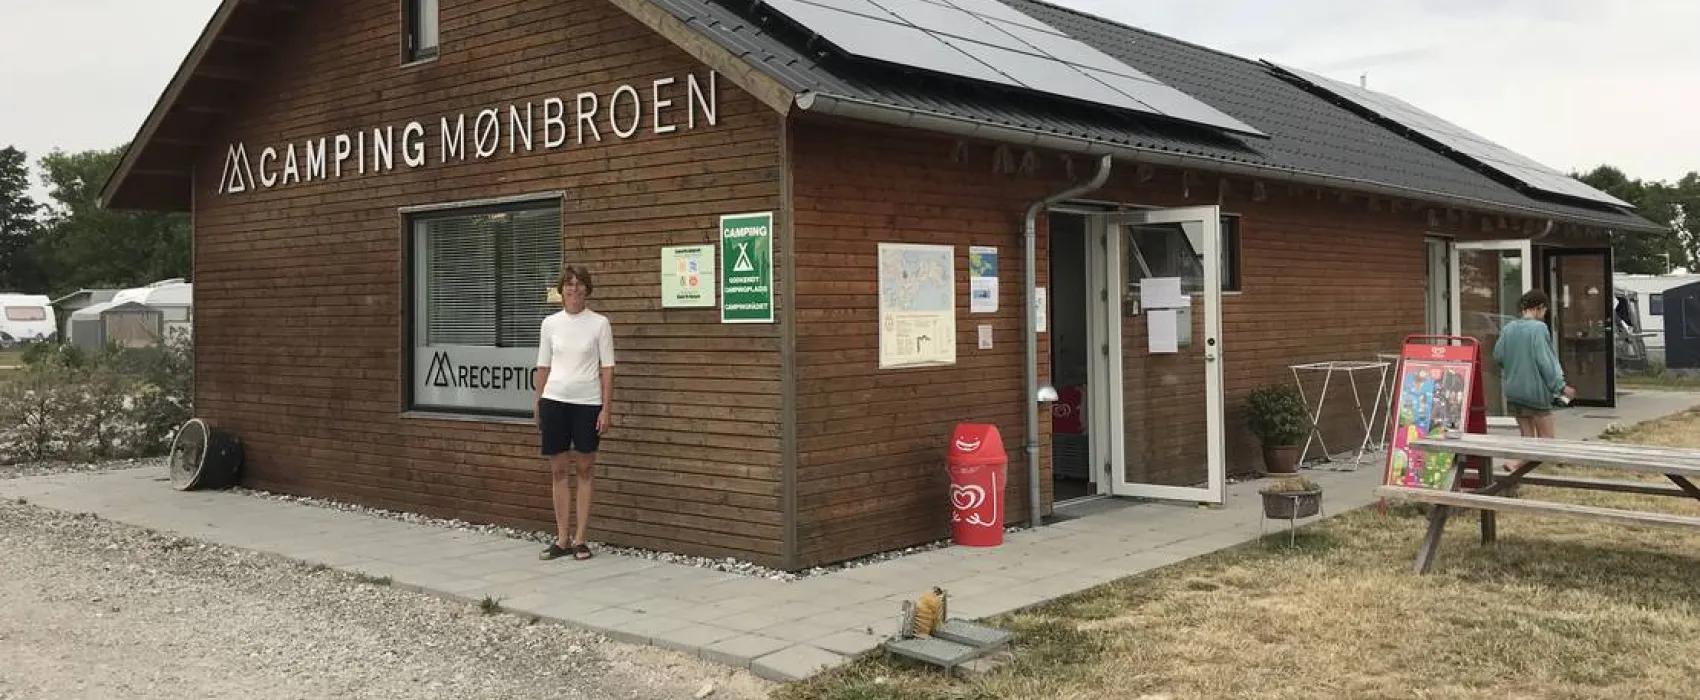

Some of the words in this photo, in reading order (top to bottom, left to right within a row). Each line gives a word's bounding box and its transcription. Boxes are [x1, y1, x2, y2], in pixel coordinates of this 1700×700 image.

[258, 120, 425, 188] CAMPING
[440, 69, 718, 163] MØNBROEN
[724, 226, 768, 238] CAMPING
[458, 365, 538, 391] RECEPTIO
